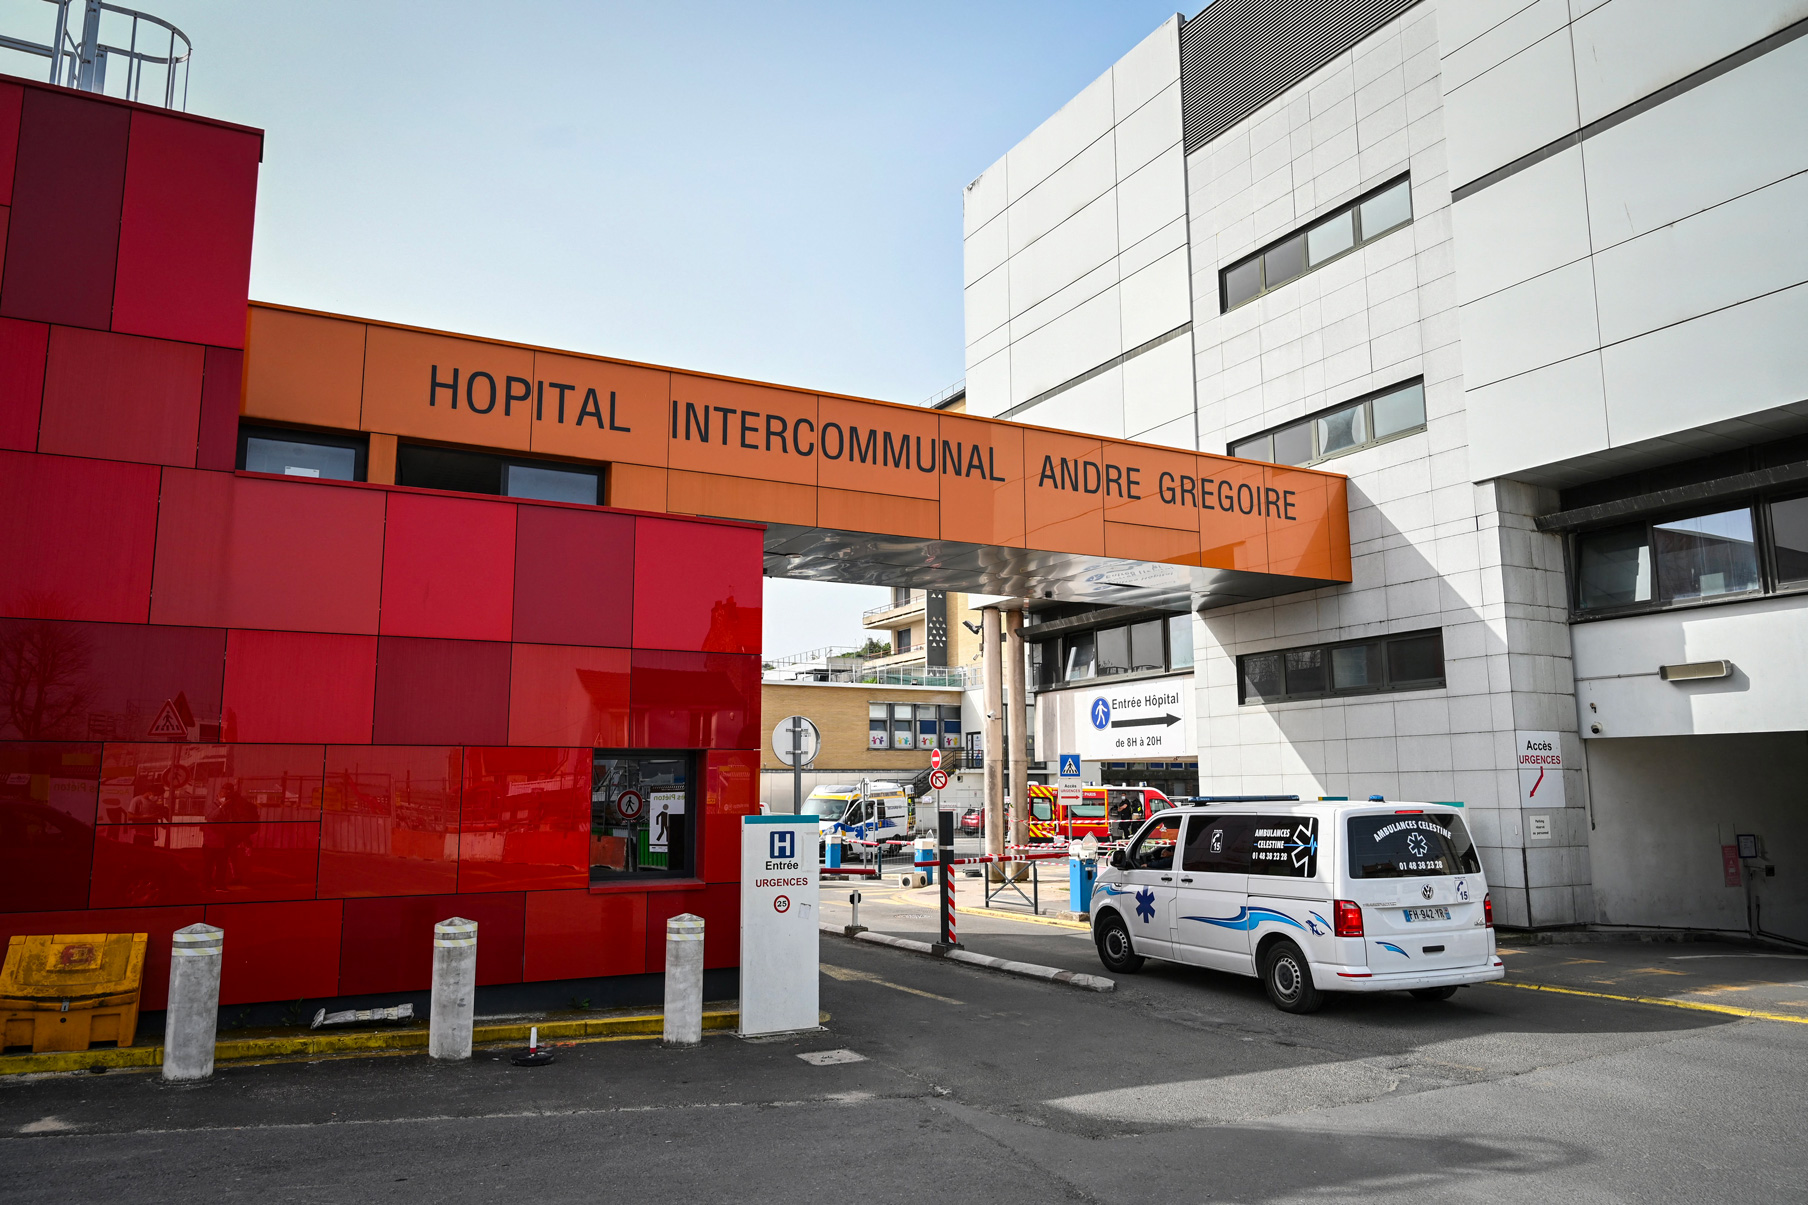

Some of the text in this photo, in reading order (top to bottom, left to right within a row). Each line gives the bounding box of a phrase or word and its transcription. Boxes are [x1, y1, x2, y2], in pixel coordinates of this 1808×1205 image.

[430, 365, 1297, 521] HOPITAL INTERCOMMUNAL ANDRE GREGOIRE
[1111, 692, 1179, 710] Entrée Hôpital
[1115, 735, 1162, 748] de 8H à 20H
[1526, 740, 1553, 751] Accès
[1519, 754, 1561, 765] URGENCES
[1254, 828, 1291, 838] AMBULANCES
[1373, 820, 1452, 842] AMBULANCES CELESTINE
[1213, 842, 1220, 850] 15
[1257, 840, 1285, 849] CELESTINE
[1252, 852, 1258, 860] 01
[765, 860, 799, 871] Entrée
[1398, 860, 1443, 870] 01 48 38 23 28
[755, 877, 809, 888] URGENCES
[1460, 890, 1468, 900] 15
[776, 900, 787, 908] 25
[1409, 908, 1446, 920] FH-942-YR
